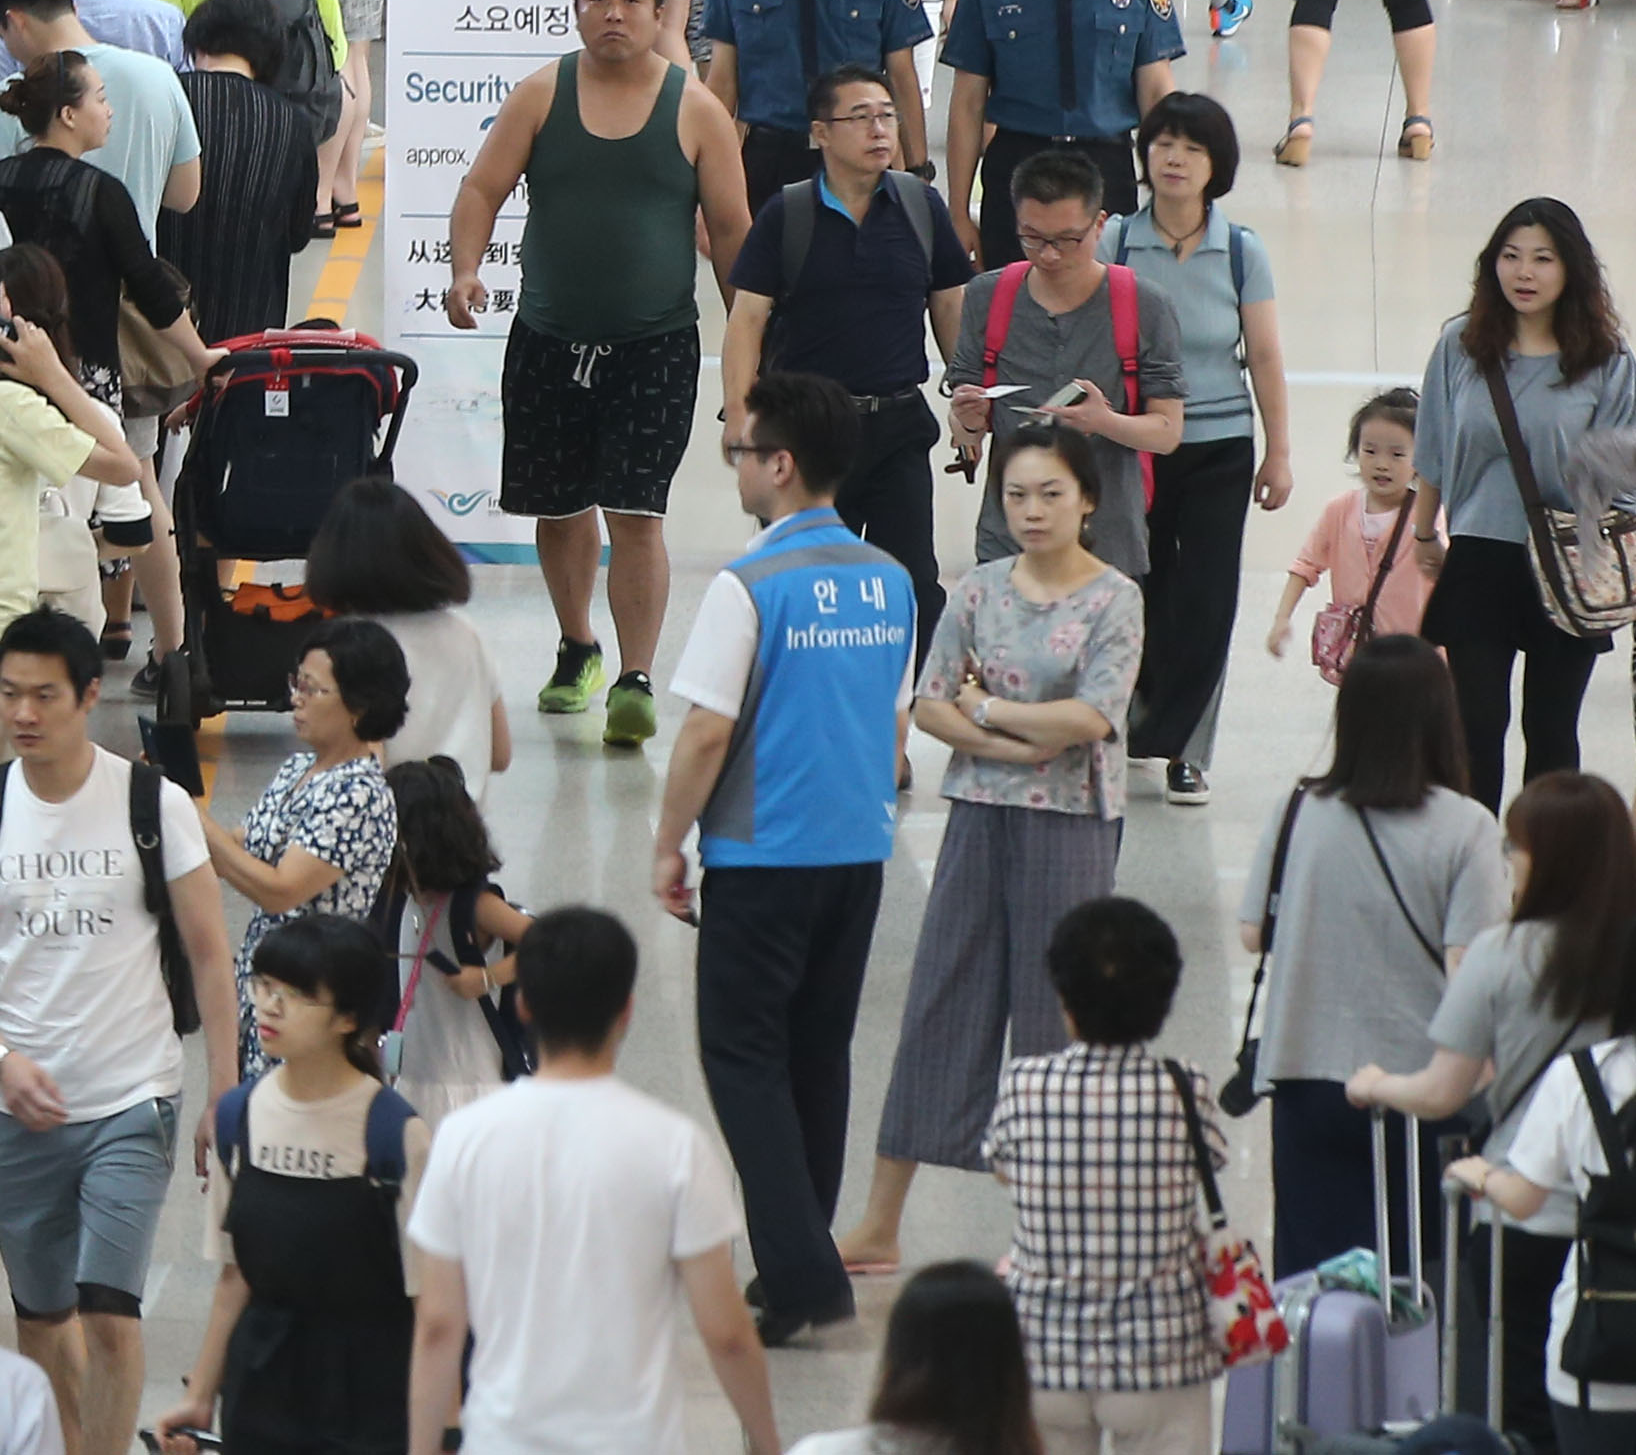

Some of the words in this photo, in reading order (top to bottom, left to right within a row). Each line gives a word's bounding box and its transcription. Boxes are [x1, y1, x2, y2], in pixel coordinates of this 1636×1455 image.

[454, 5, 571, 38] 소요예정
[813, 577, 839, 614] 안
[859, 576, 886, 612] 내
[786, 620, 906, 651] Information
[15, 907, 116, 939] YOURS
